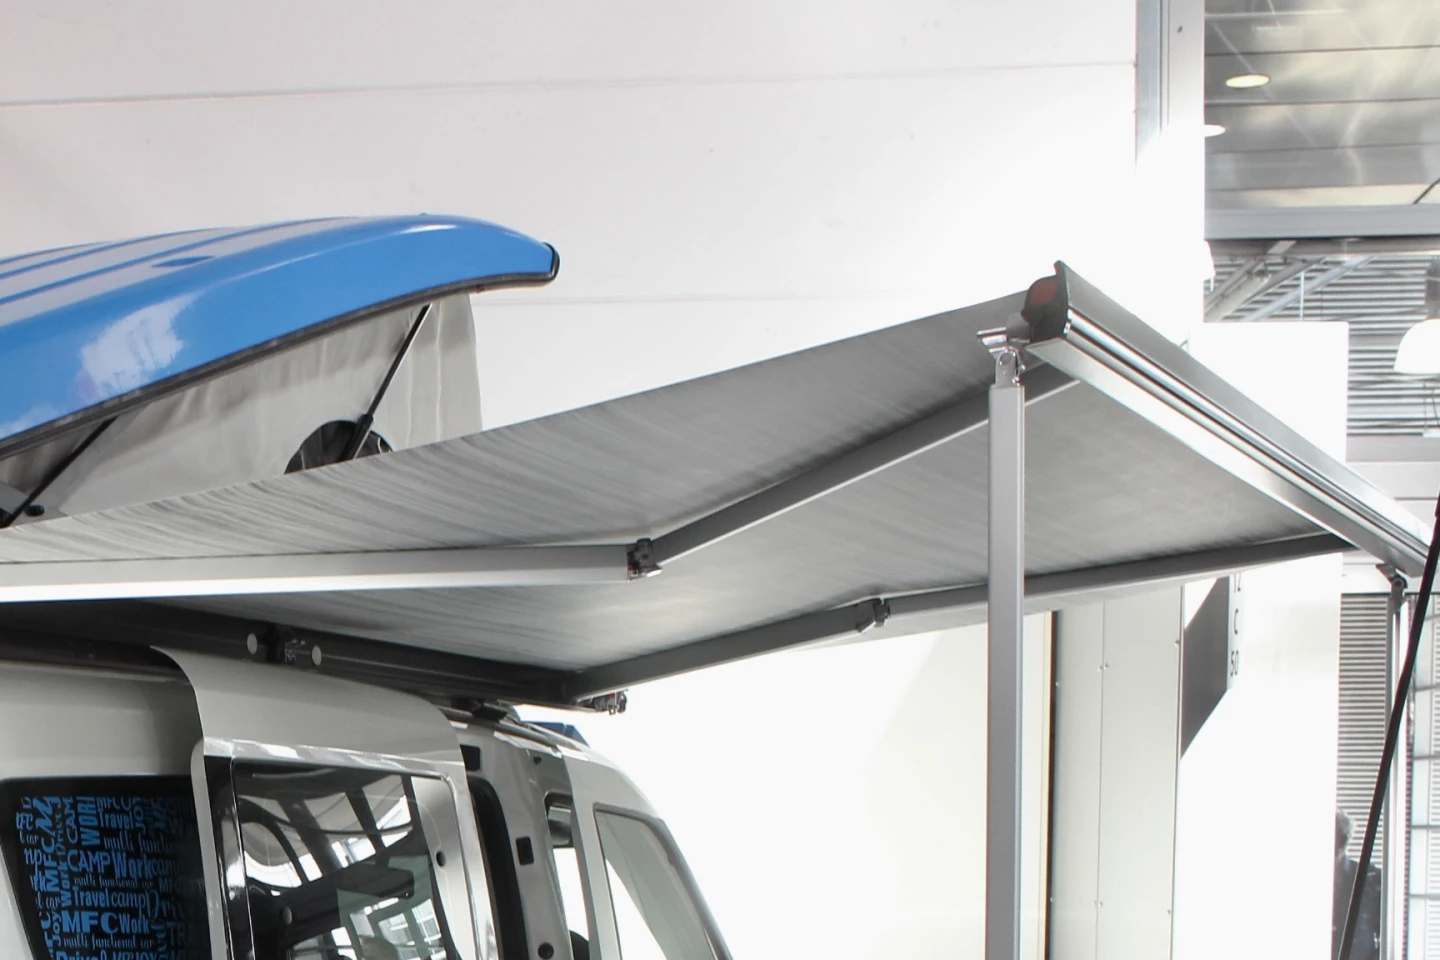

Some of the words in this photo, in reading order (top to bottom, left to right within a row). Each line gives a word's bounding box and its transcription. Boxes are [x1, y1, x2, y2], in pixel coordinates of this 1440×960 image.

[97, 807, 135, 830] Travel
[67, 849, 110, 873] CAMP
[111, 852, 153, 879] Work
[73, 887, 109, 908] Travel
[111, 891, 146, 919] camp
[61, 909, 119, 934] MFC
[118, 912, 150, 935] Work
